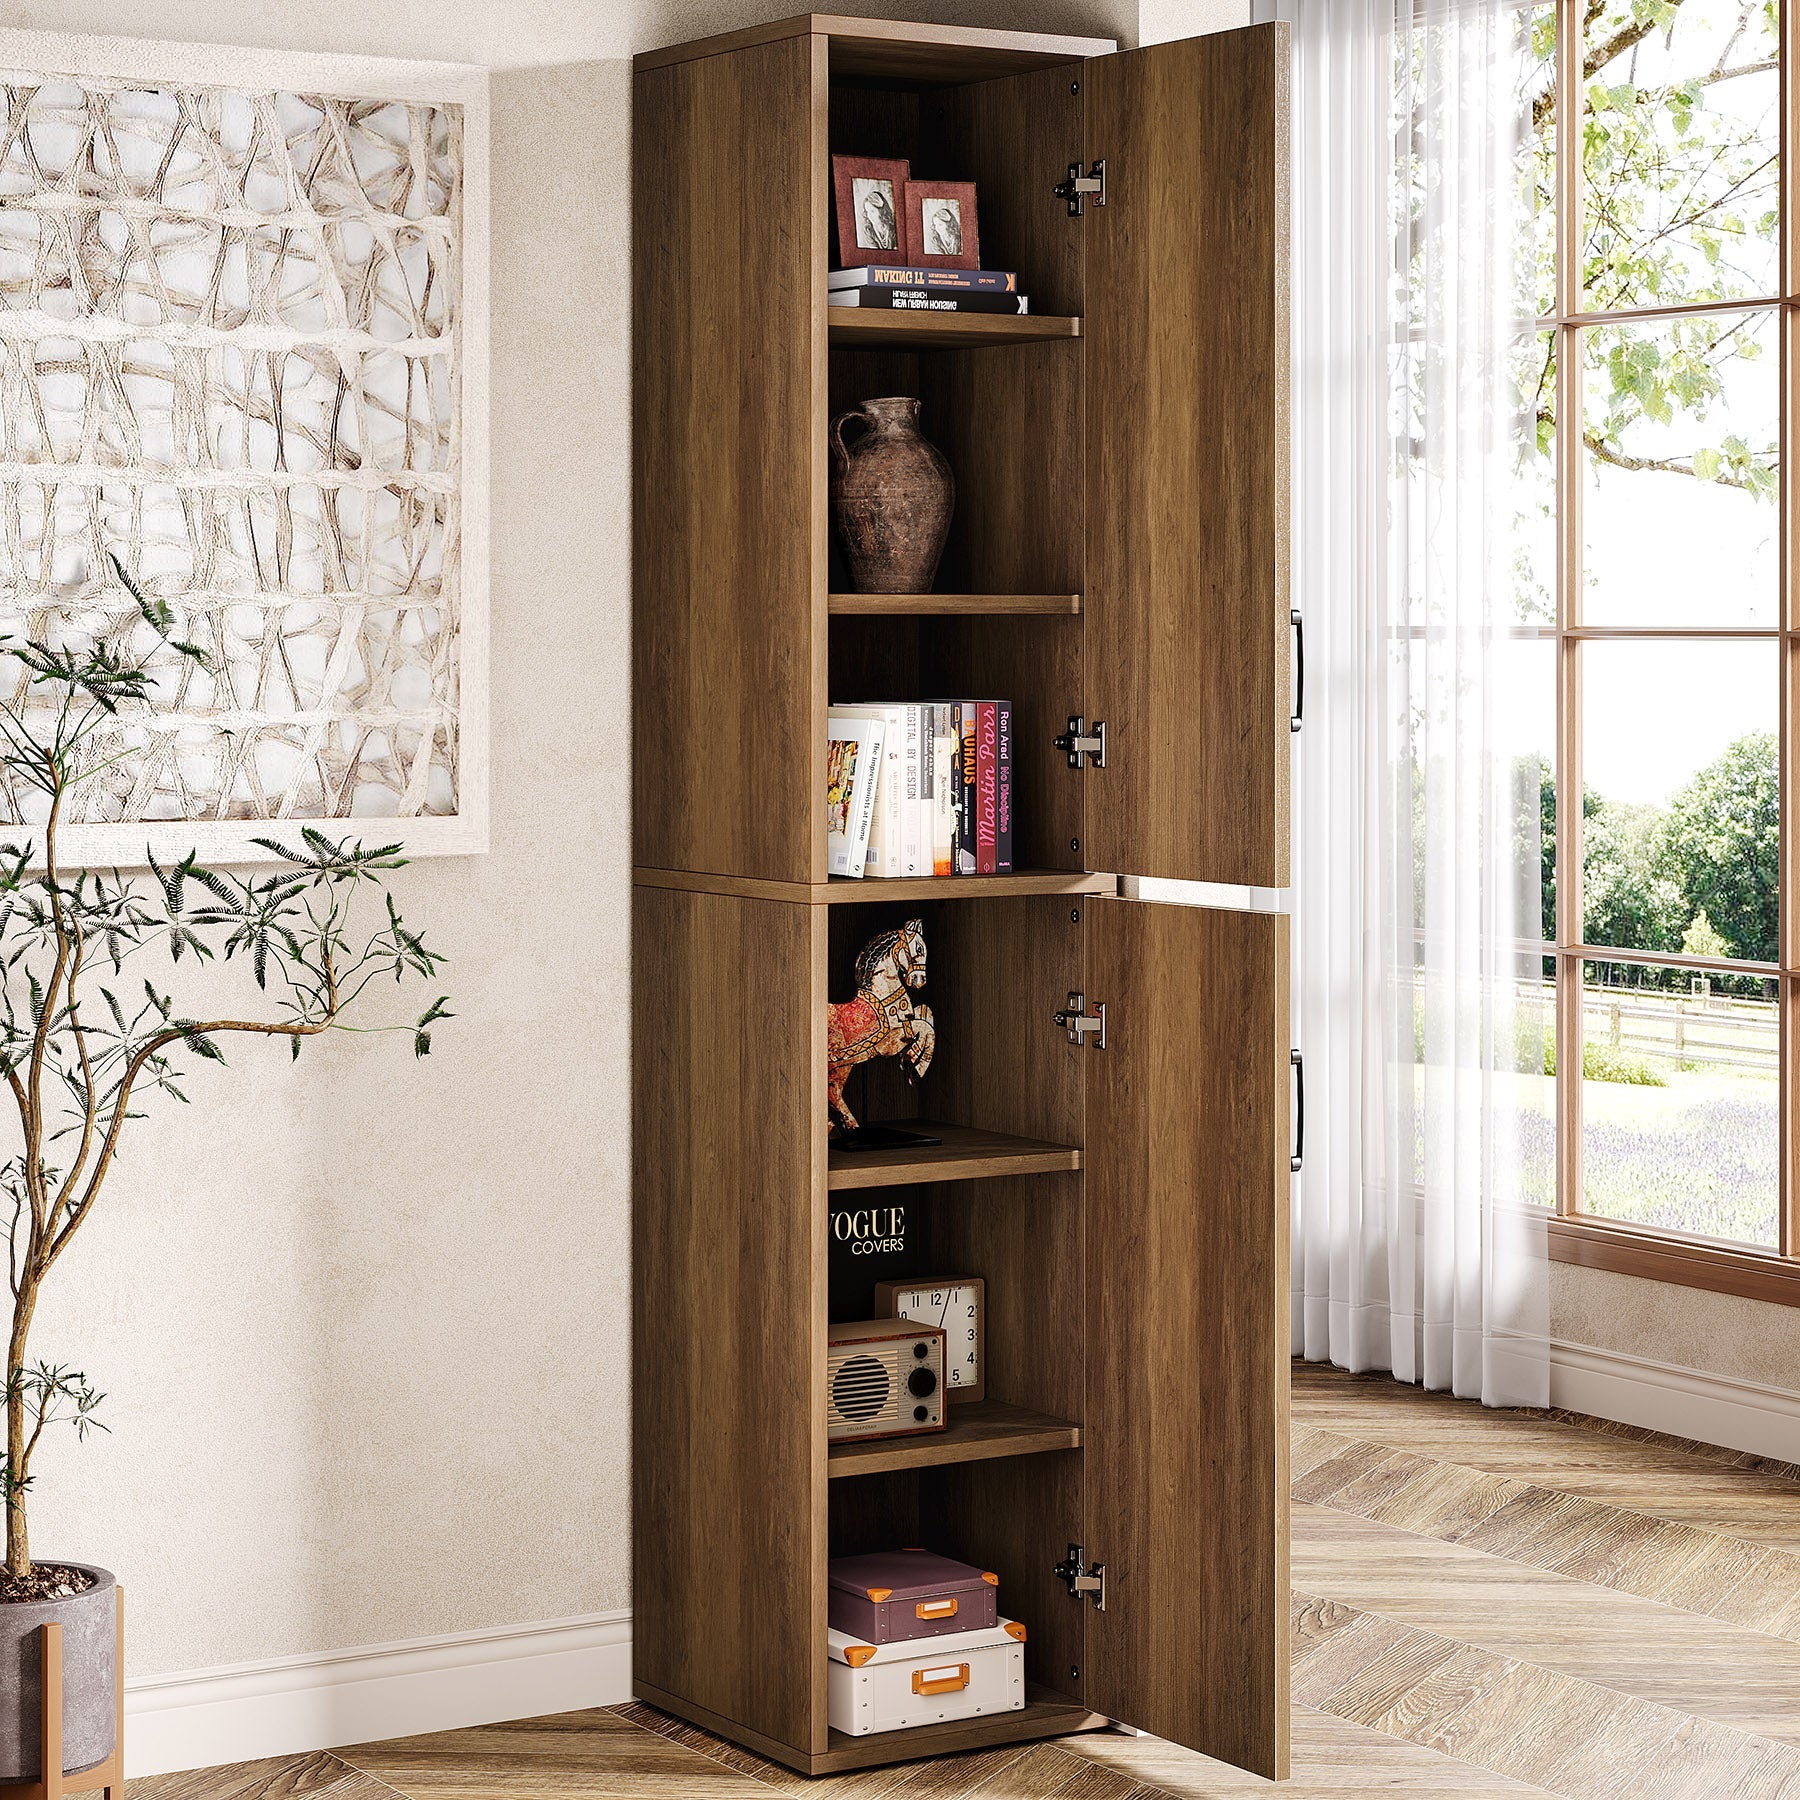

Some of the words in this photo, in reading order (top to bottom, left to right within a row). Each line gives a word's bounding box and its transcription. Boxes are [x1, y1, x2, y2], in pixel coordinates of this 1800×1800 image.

[907, 707, 916, 743] DIGITAL
[1000, 711, 1009, 732] Ron
[979, 705, 995, 760] Parr
[873, 742, 881, 755] The
[907, 749, 916, 760] BY
[963, 719, 976, 785] BAUHAUS
[1000, 735, 1009, 759] Arad
[864, 757, 878, 808] Impressionists
[907, 766, 916, 799] DESIGN
[1000, 766, 1009, 781] No
[979, 766, 995, 842] Martin
[999, 784, 1009, 833] Discipline
[859, 820, 868, 841] Home
[851, 1237, 904, 1255] COVERS
[912, 1295, 920, 1308] 11
[930, 1292, 942, 1306] 12
[954, 1291, 958, 1304] 1
[967, 1305, 975, 1318] 2
[967, 1329, 975, 1341] 3
[966, 1352, 975, 1364] 4
[952, 1369, 960, 1382] 5
